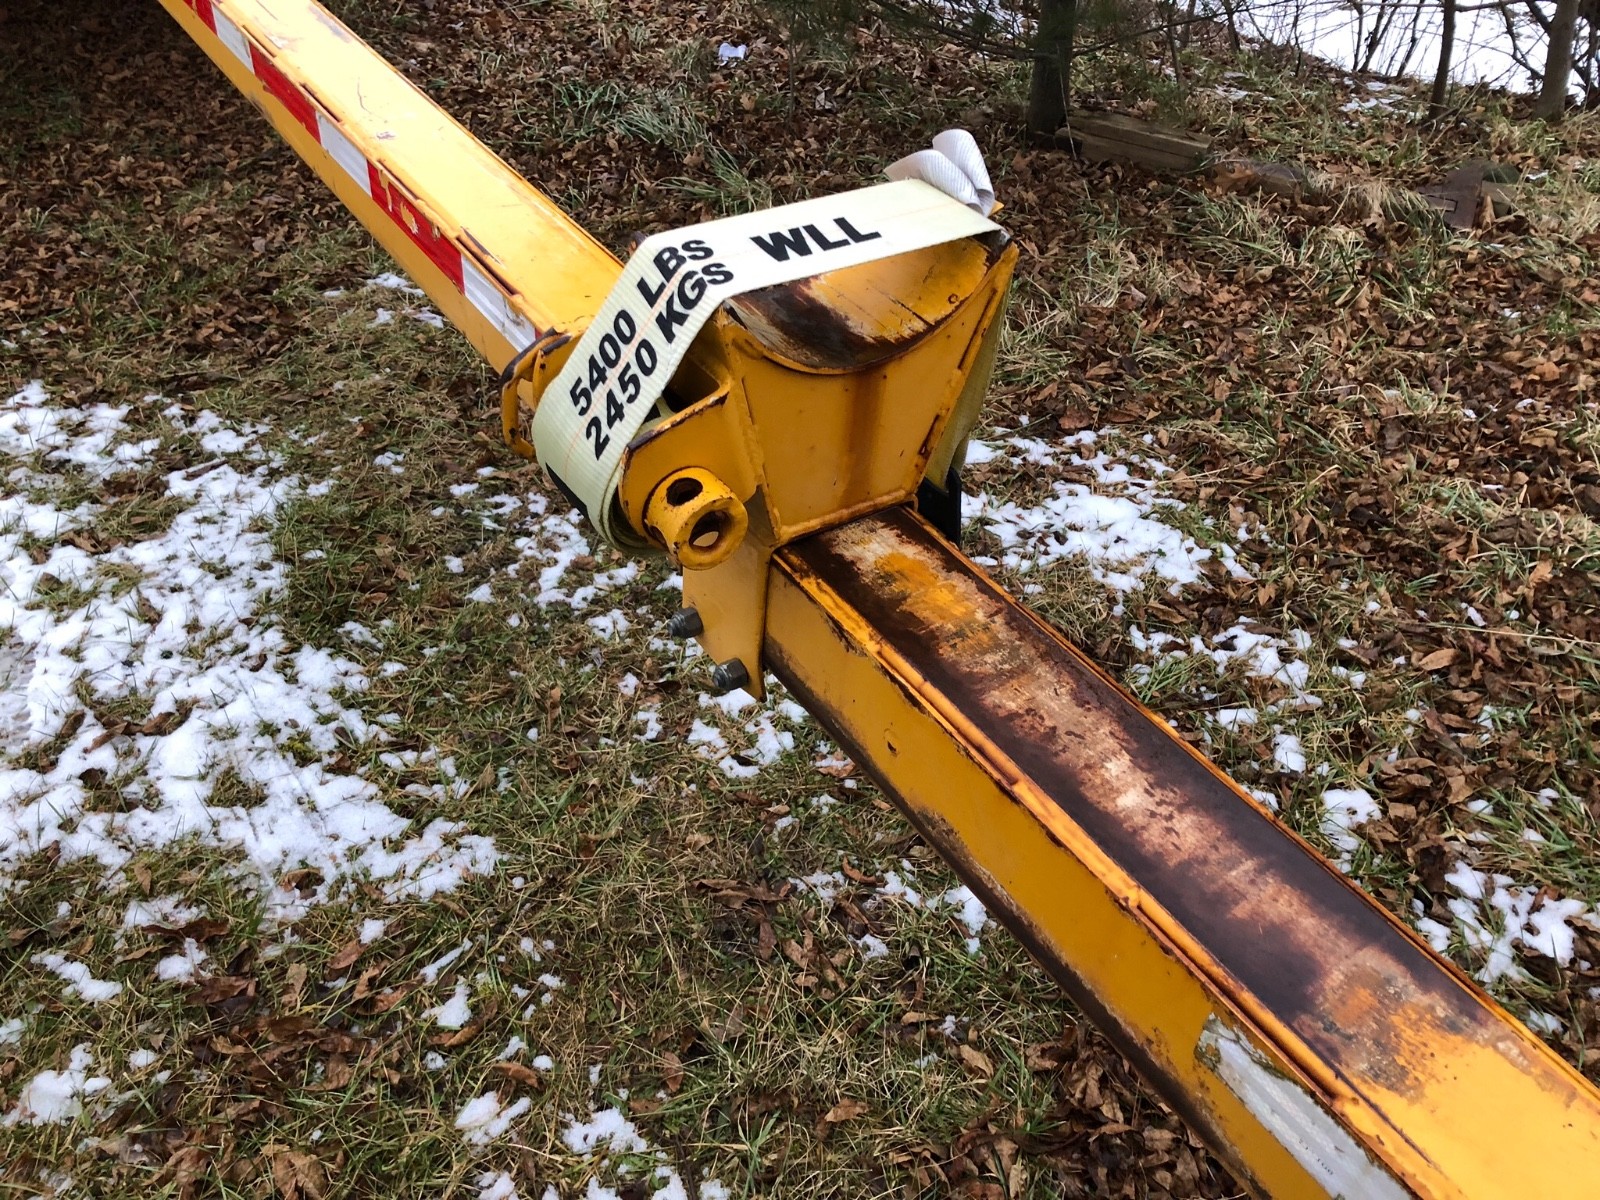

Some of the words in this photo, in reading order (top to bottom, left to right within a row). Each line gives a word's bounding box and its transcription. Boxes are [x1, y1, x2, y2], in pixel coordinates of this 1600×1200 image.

[569, 309, 637, 417] 5400
[636, 239, 714, 309] LBS
[750, 217, 882, 262] WLL
[585, 338, 658, 461] 2450
[655, 263, 735, 344] KGS
